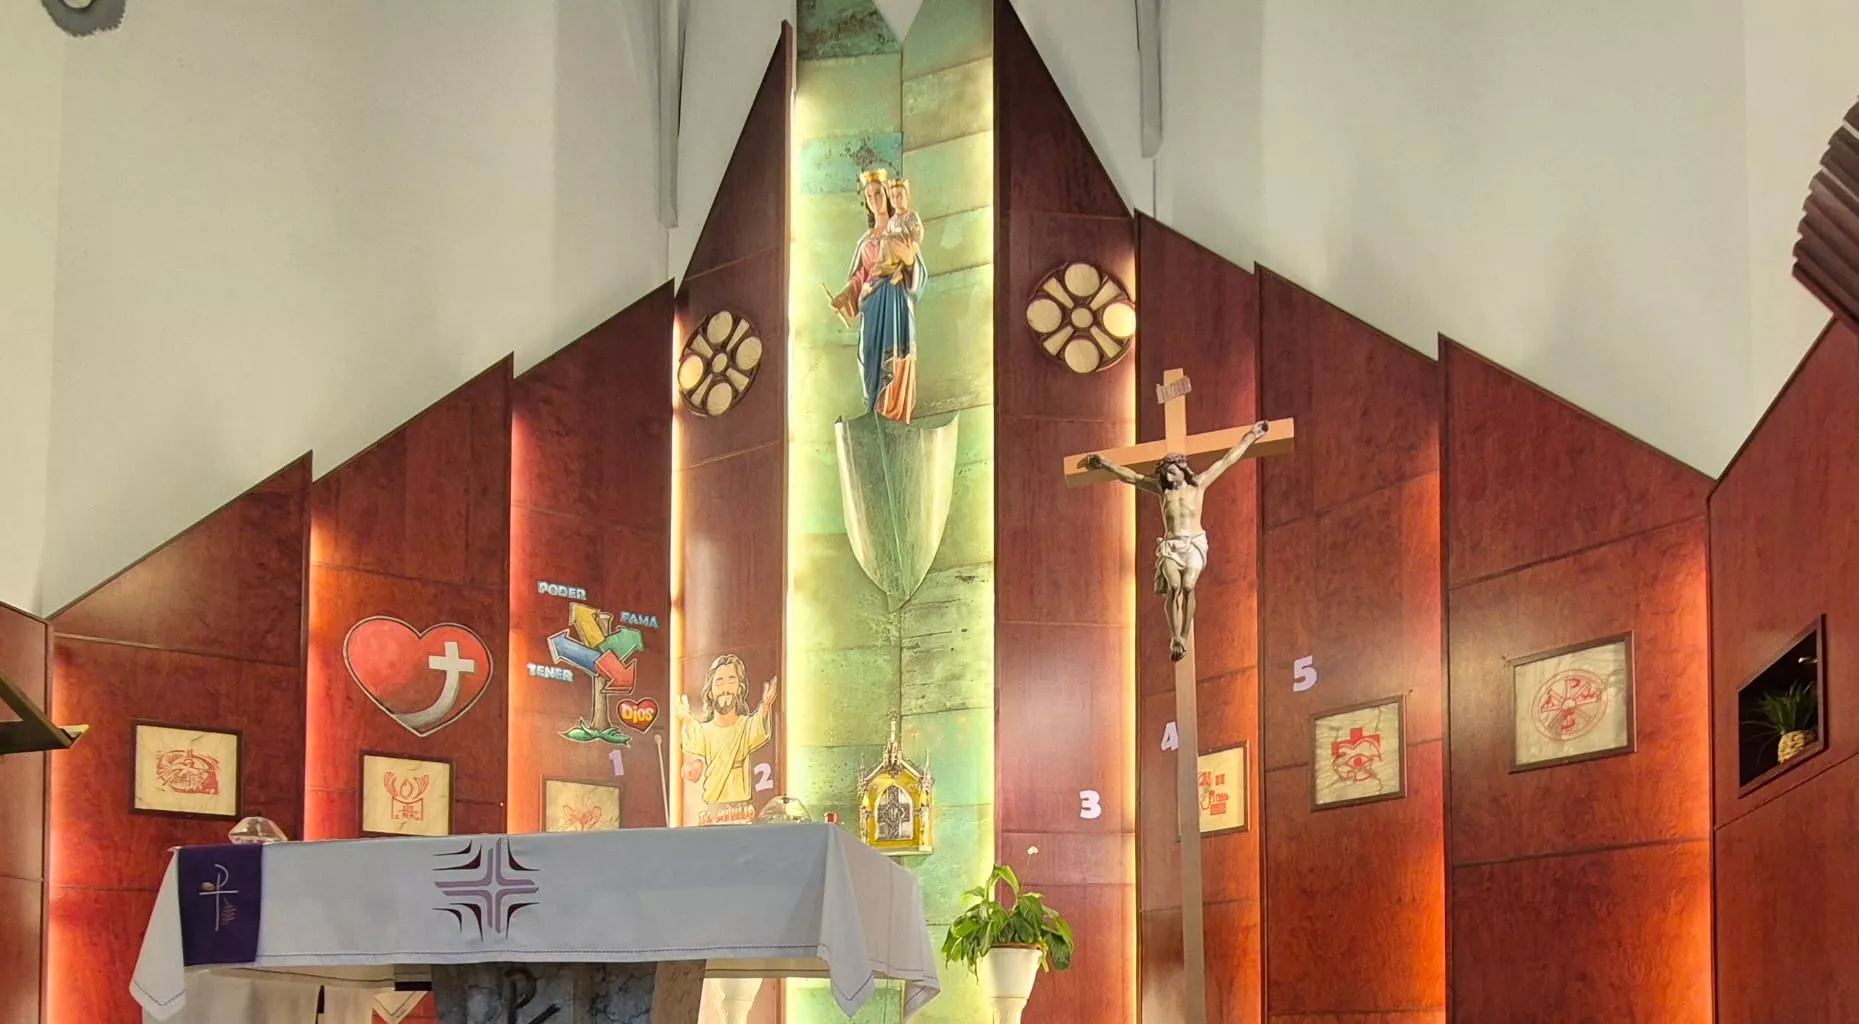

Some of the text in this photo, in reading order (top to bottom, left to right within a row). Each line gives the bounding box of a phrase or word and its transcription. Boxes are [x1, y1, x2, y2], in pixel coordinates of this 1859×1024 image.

[537, 581, 587, 600] PODER
[619, 610, 659, 628] FAMA
[526, 663, 575, 682] TENER
[1292, 655, 1318, 693] 5
[1160, 721, 1180, 752] 4
[608, 749, 625, 776] 1
[753, 762, 774, 792] 2
[1079, 789, 1102, 819] 3
